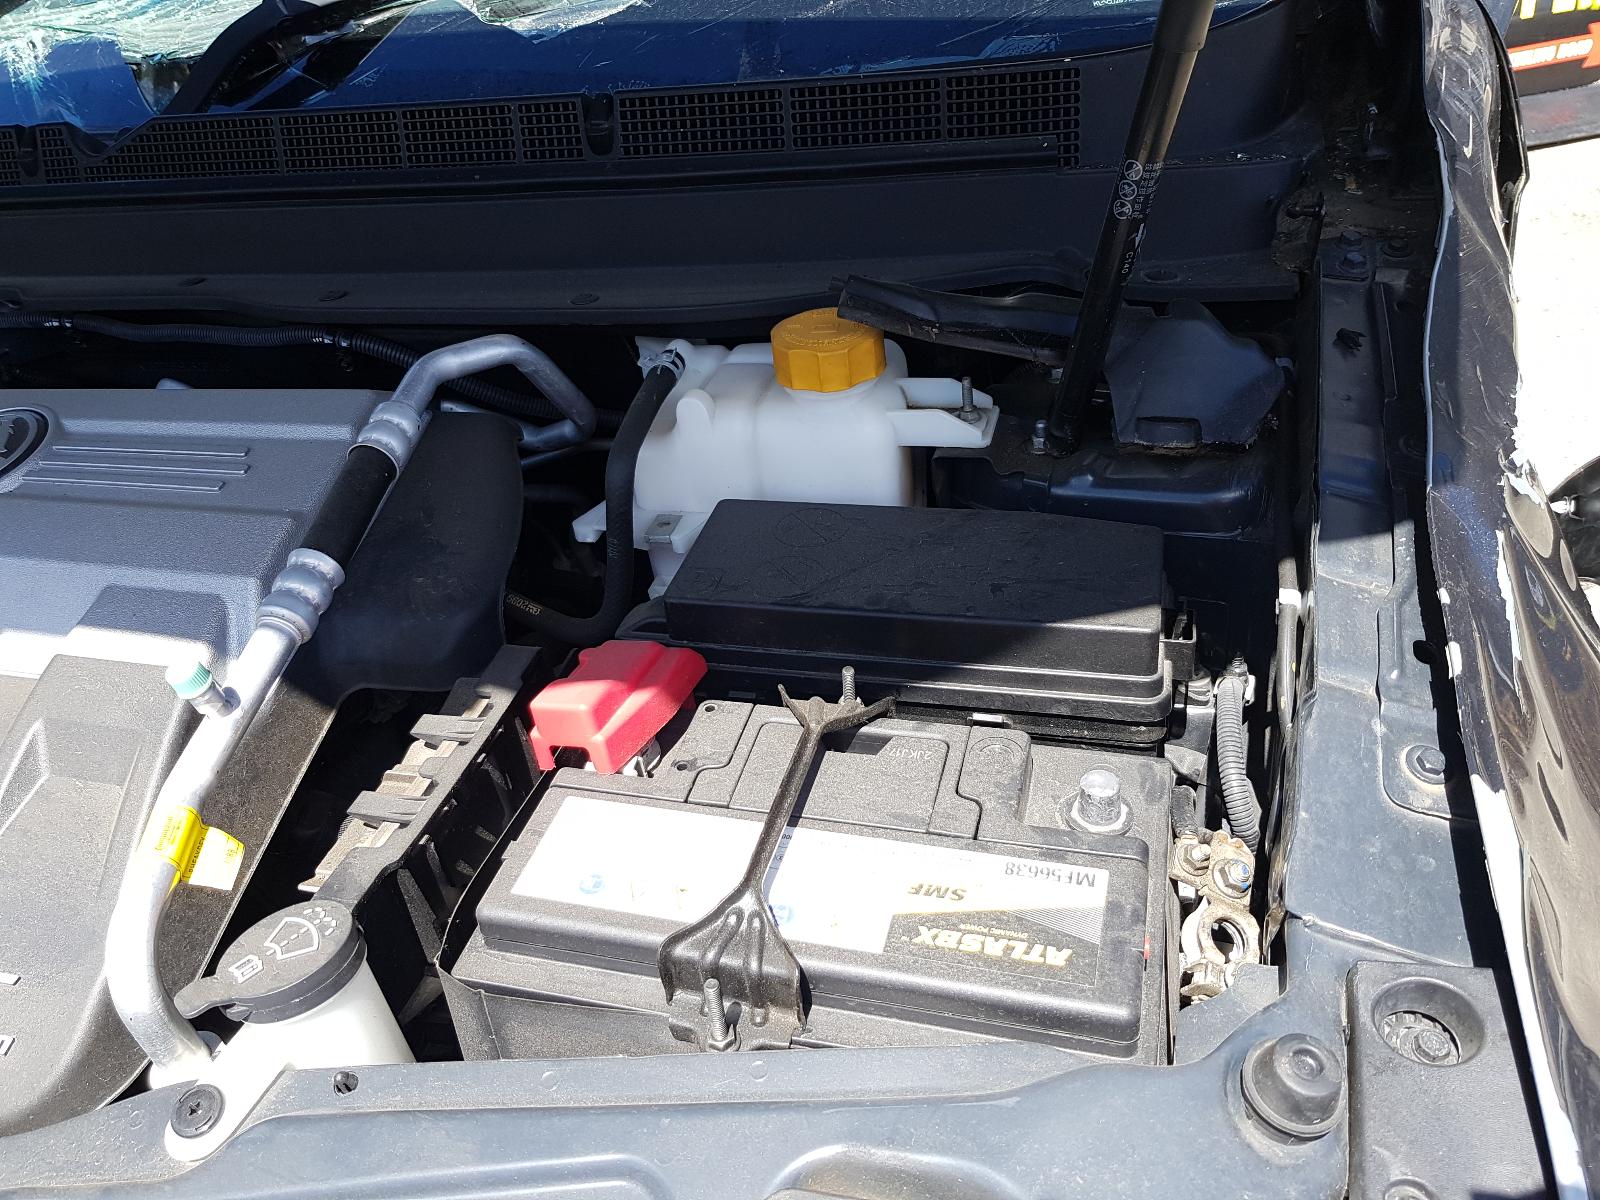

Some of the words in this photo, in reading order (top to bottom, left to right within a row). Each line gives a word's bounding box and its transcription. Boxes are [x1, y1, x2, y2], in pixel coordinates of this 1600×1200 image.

[1004, 861, 1097, 888] MF56638
[907, 882, 967, 902] SMF
[959, 922, 990, 934] POWER
[989, 926, 1029, 941] DYNAMIC
[910, 924, 1074, 968] ATLASBX
